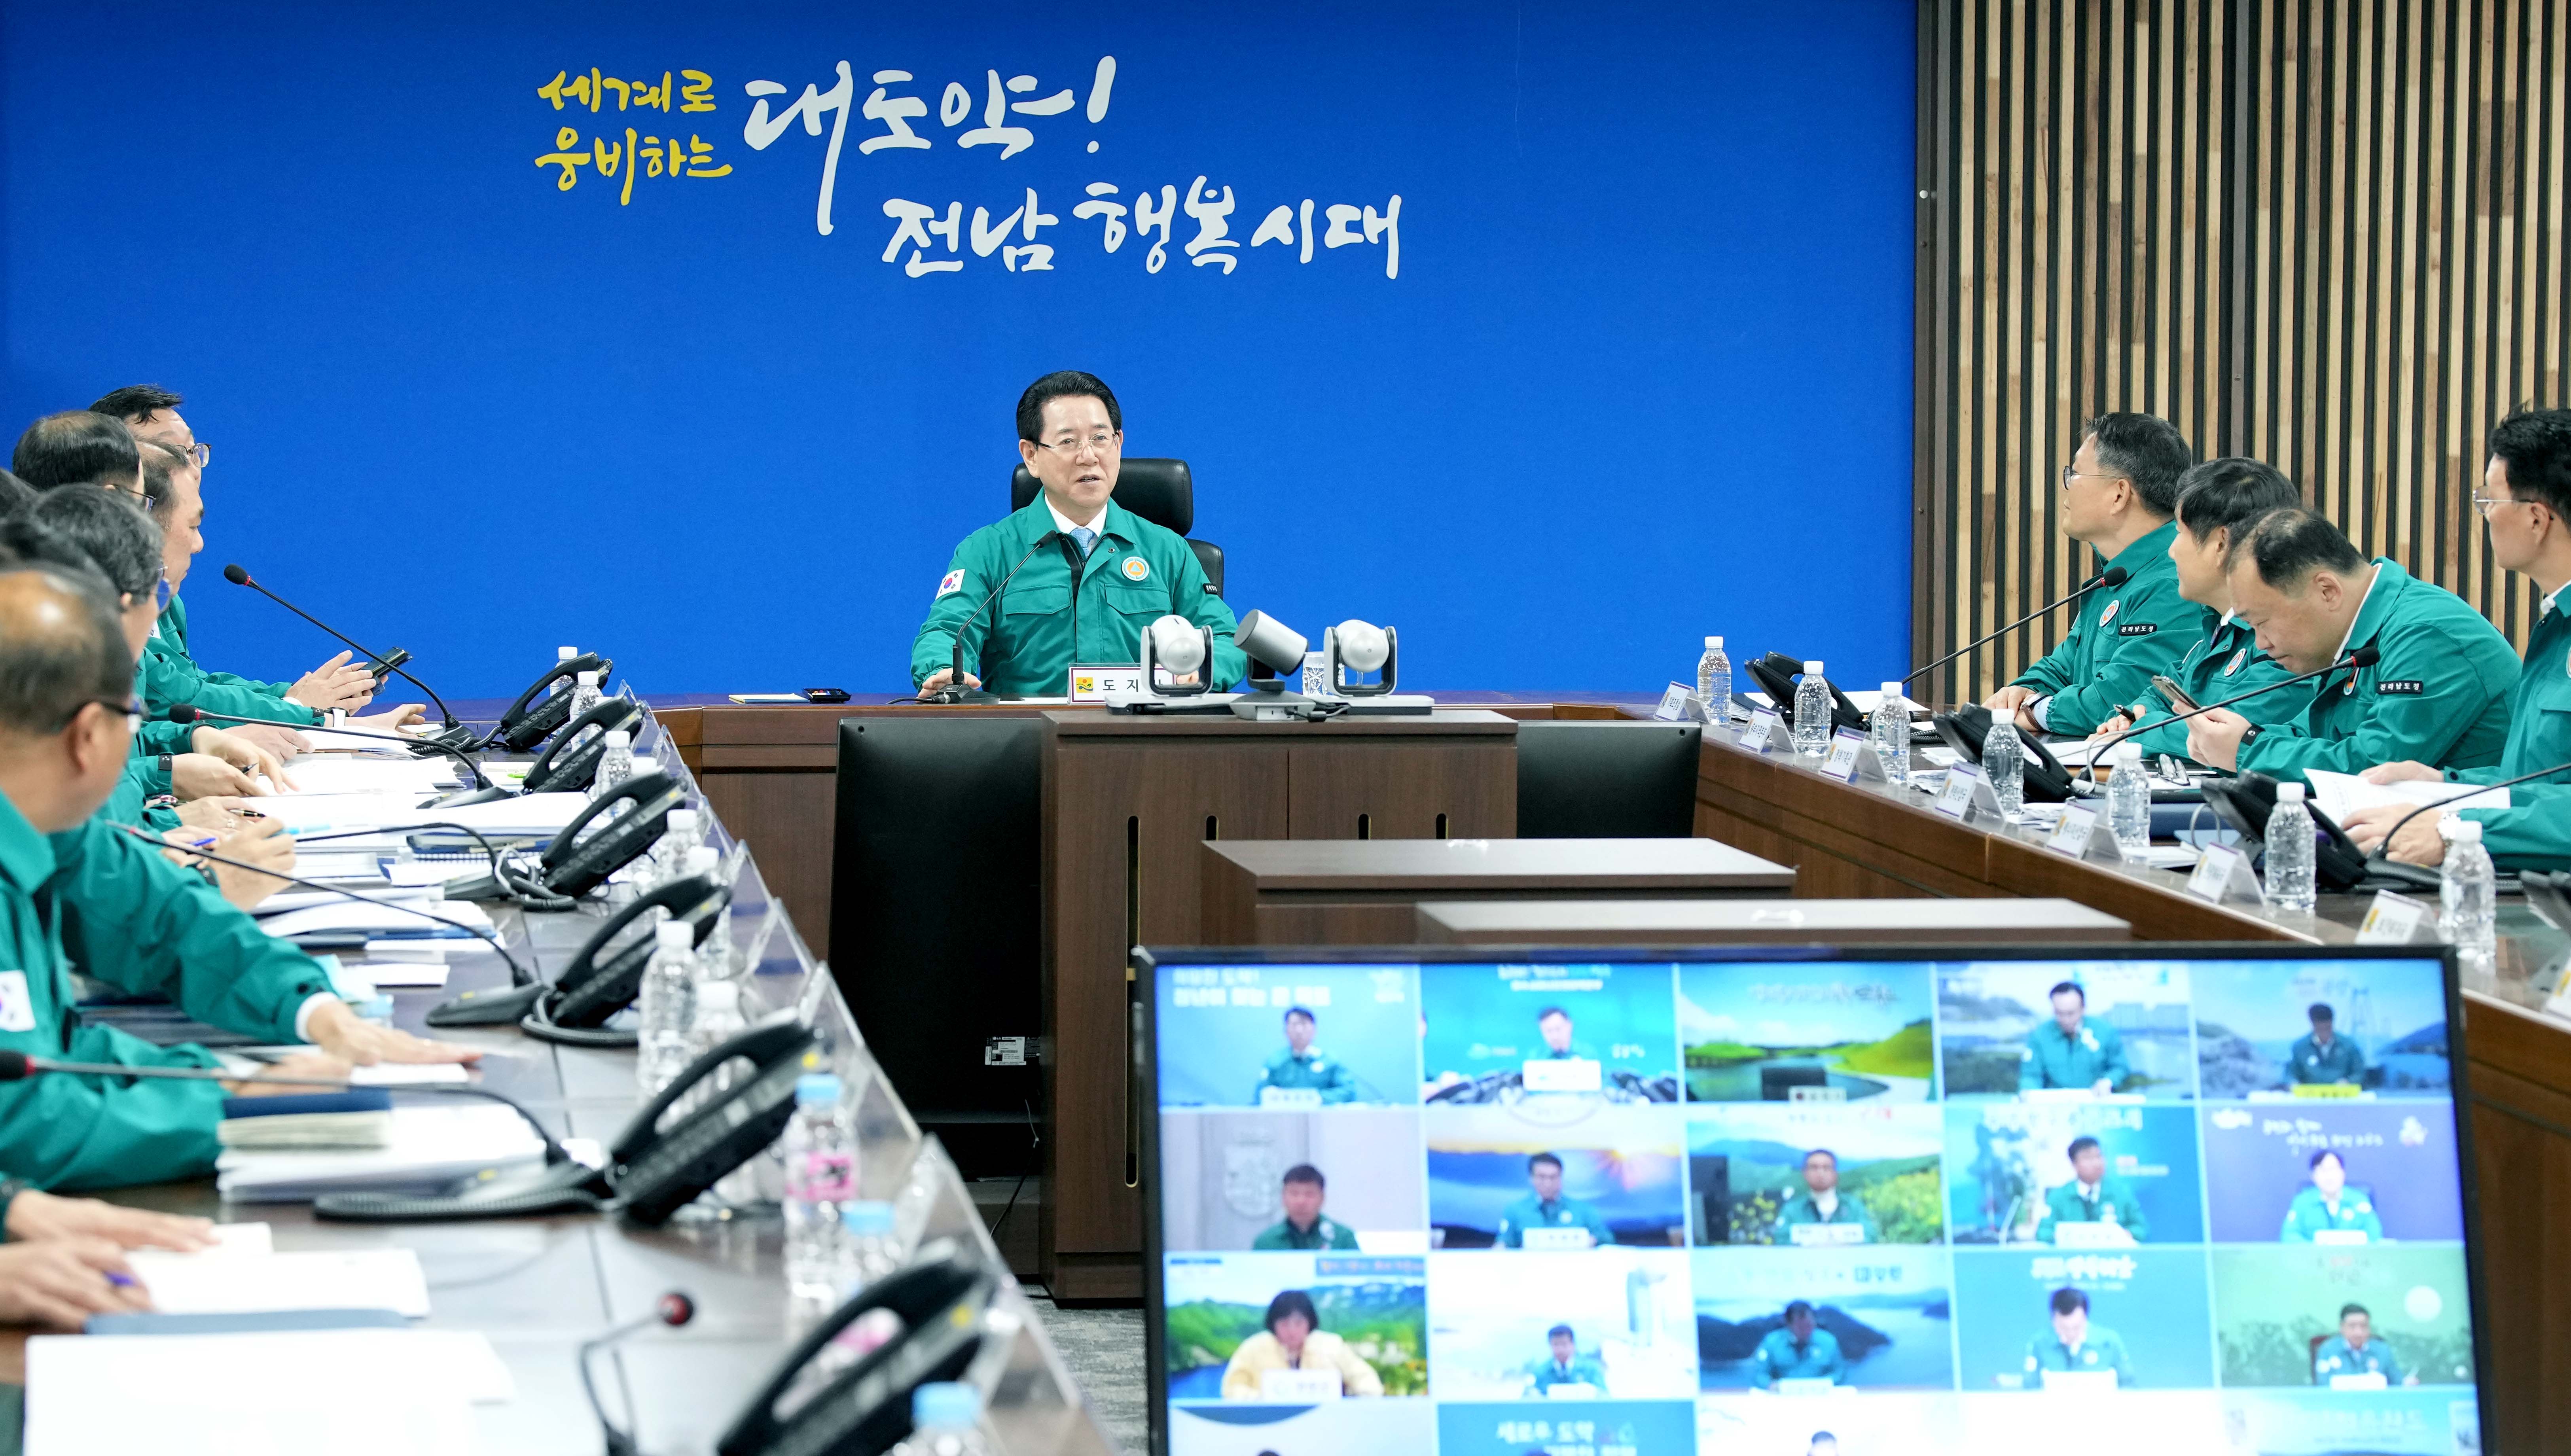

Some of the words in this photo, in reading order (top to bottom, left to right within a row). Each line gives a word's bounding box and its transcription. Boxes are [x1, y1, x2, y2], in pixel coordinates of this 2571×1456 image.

[538, 68, 716, 113] 세계로
[535, 127, 732, 205] 웅비하는
[744, 56, 1116, 235] 대도약!
[882, 187, 1059, 278] 전남
